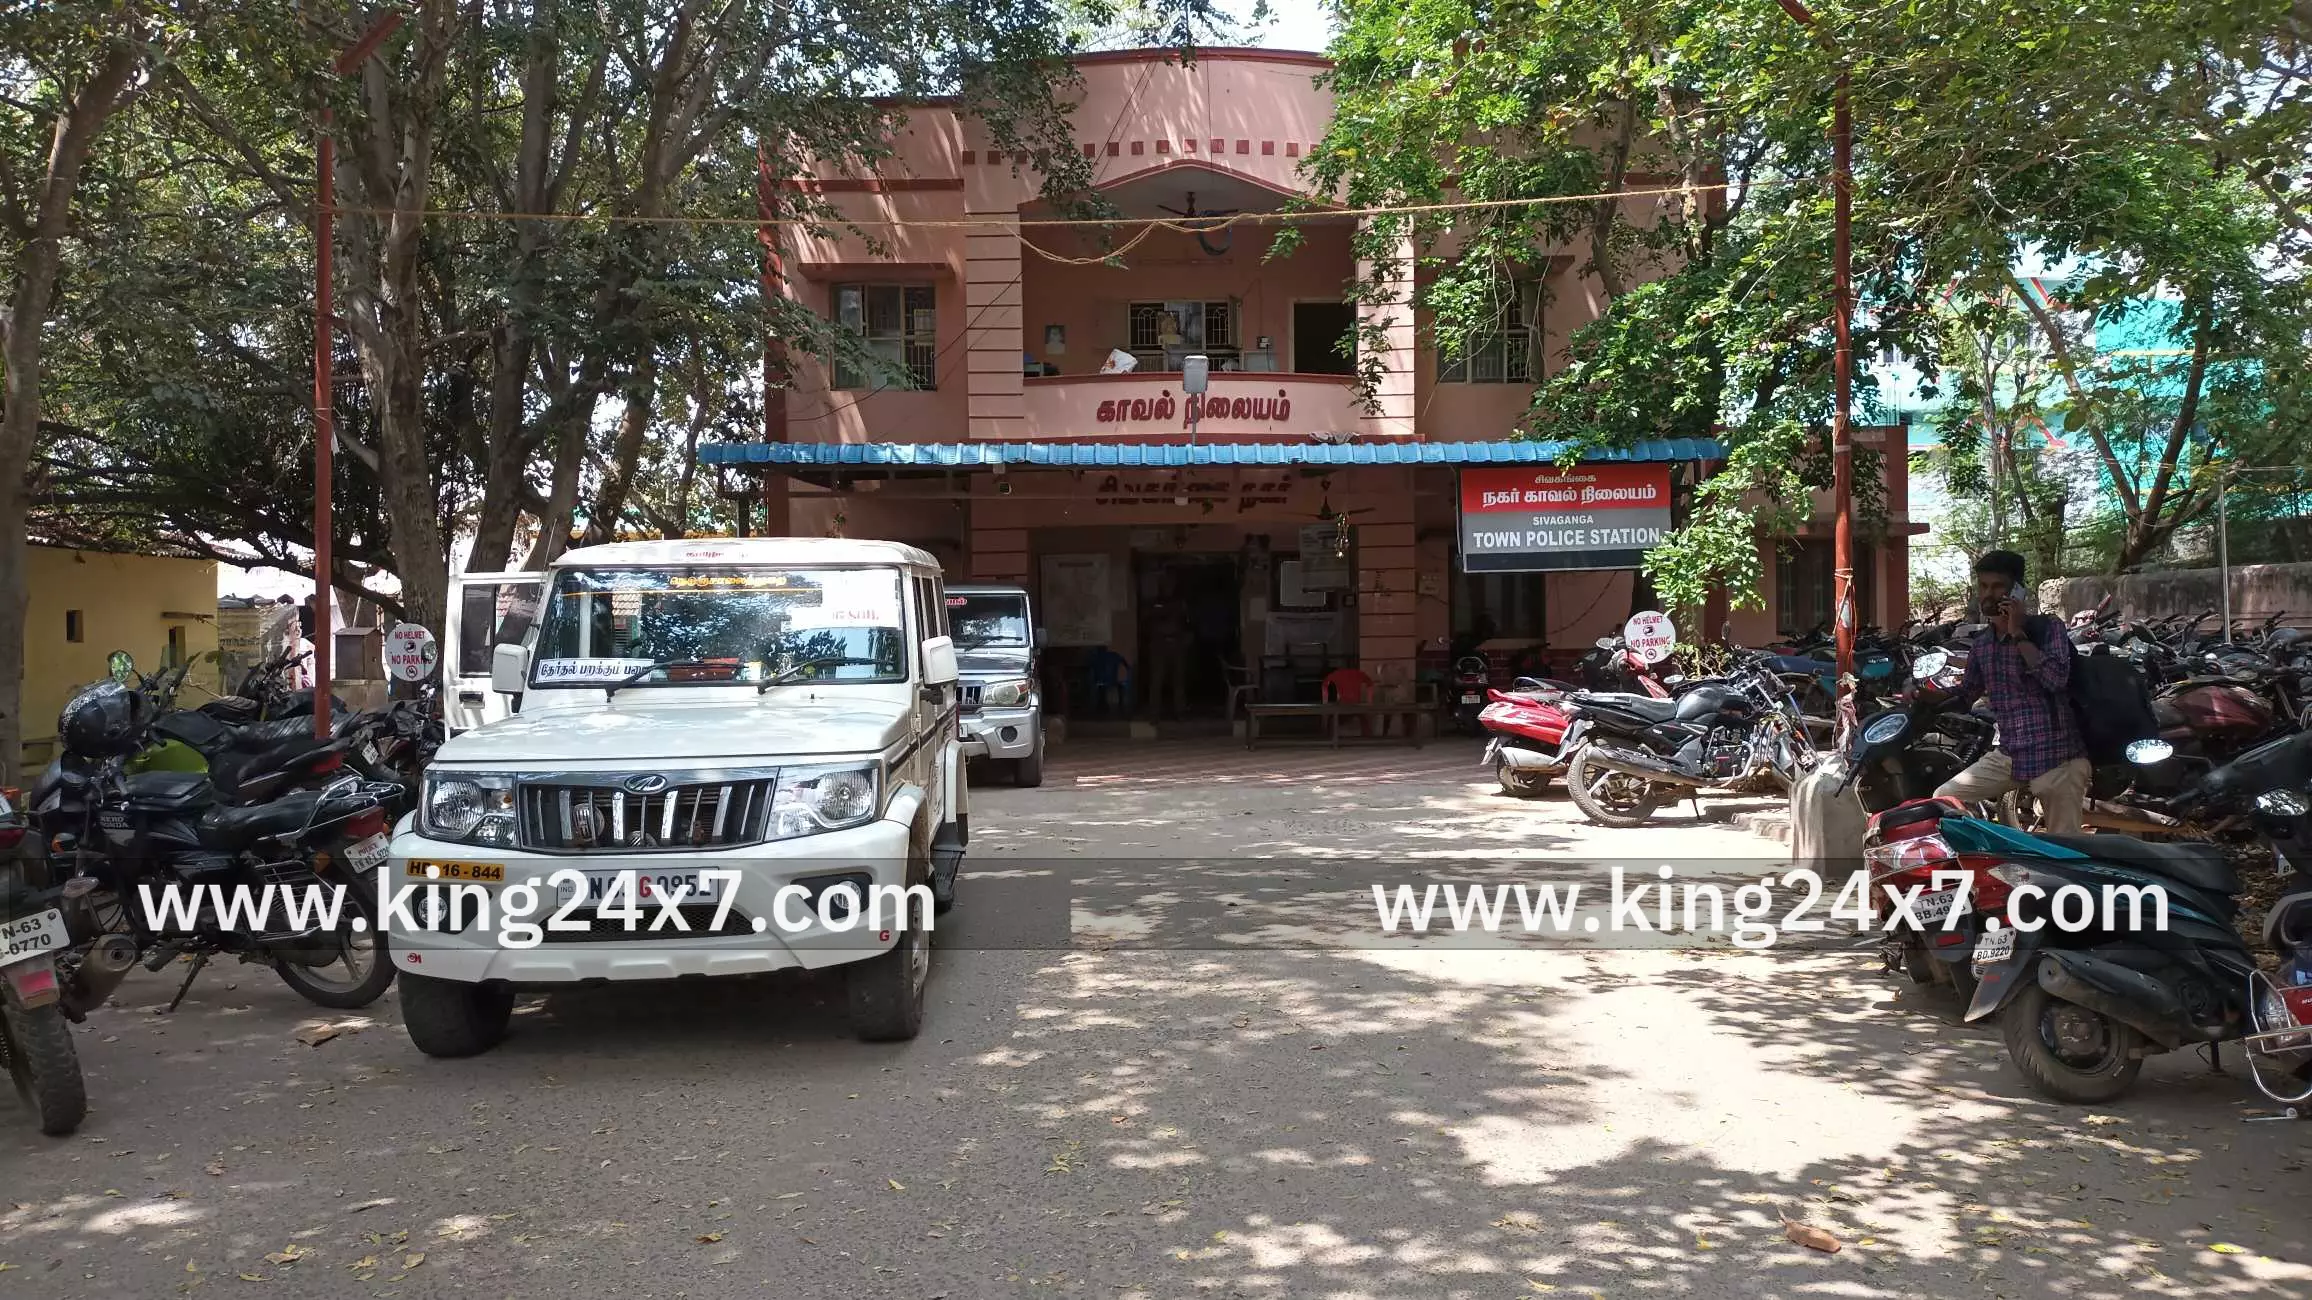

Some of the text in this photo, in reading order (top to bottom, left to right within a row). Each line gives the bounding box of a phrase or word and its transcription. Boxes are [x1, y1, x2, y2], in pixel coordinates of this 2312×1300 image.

[1096, 389, 1291, 429] காவல் நிலையம்
[1482, 483, 1657, 508] நகர் காவல் நிலையம்
[1533, 514, 1594, 526] SIVAGANGA
[1473, 527, 1660, 548] TOWN POLICE STATION
[1633, 616, 1663, 625] NO HELMET
[395, 631, 425, 639] NO HELMET
[1631, 636, 1671, 648] NO PARKING
[391, 655, 402, 665] NO
[540, 661, 578, 677] தேர்தல்
[1914, 905, 1967, 921] BB.49
[0, 918, 42, 939] N-63
[879, 930, 890, 941] G
[407, 952, 422, 964] அ
